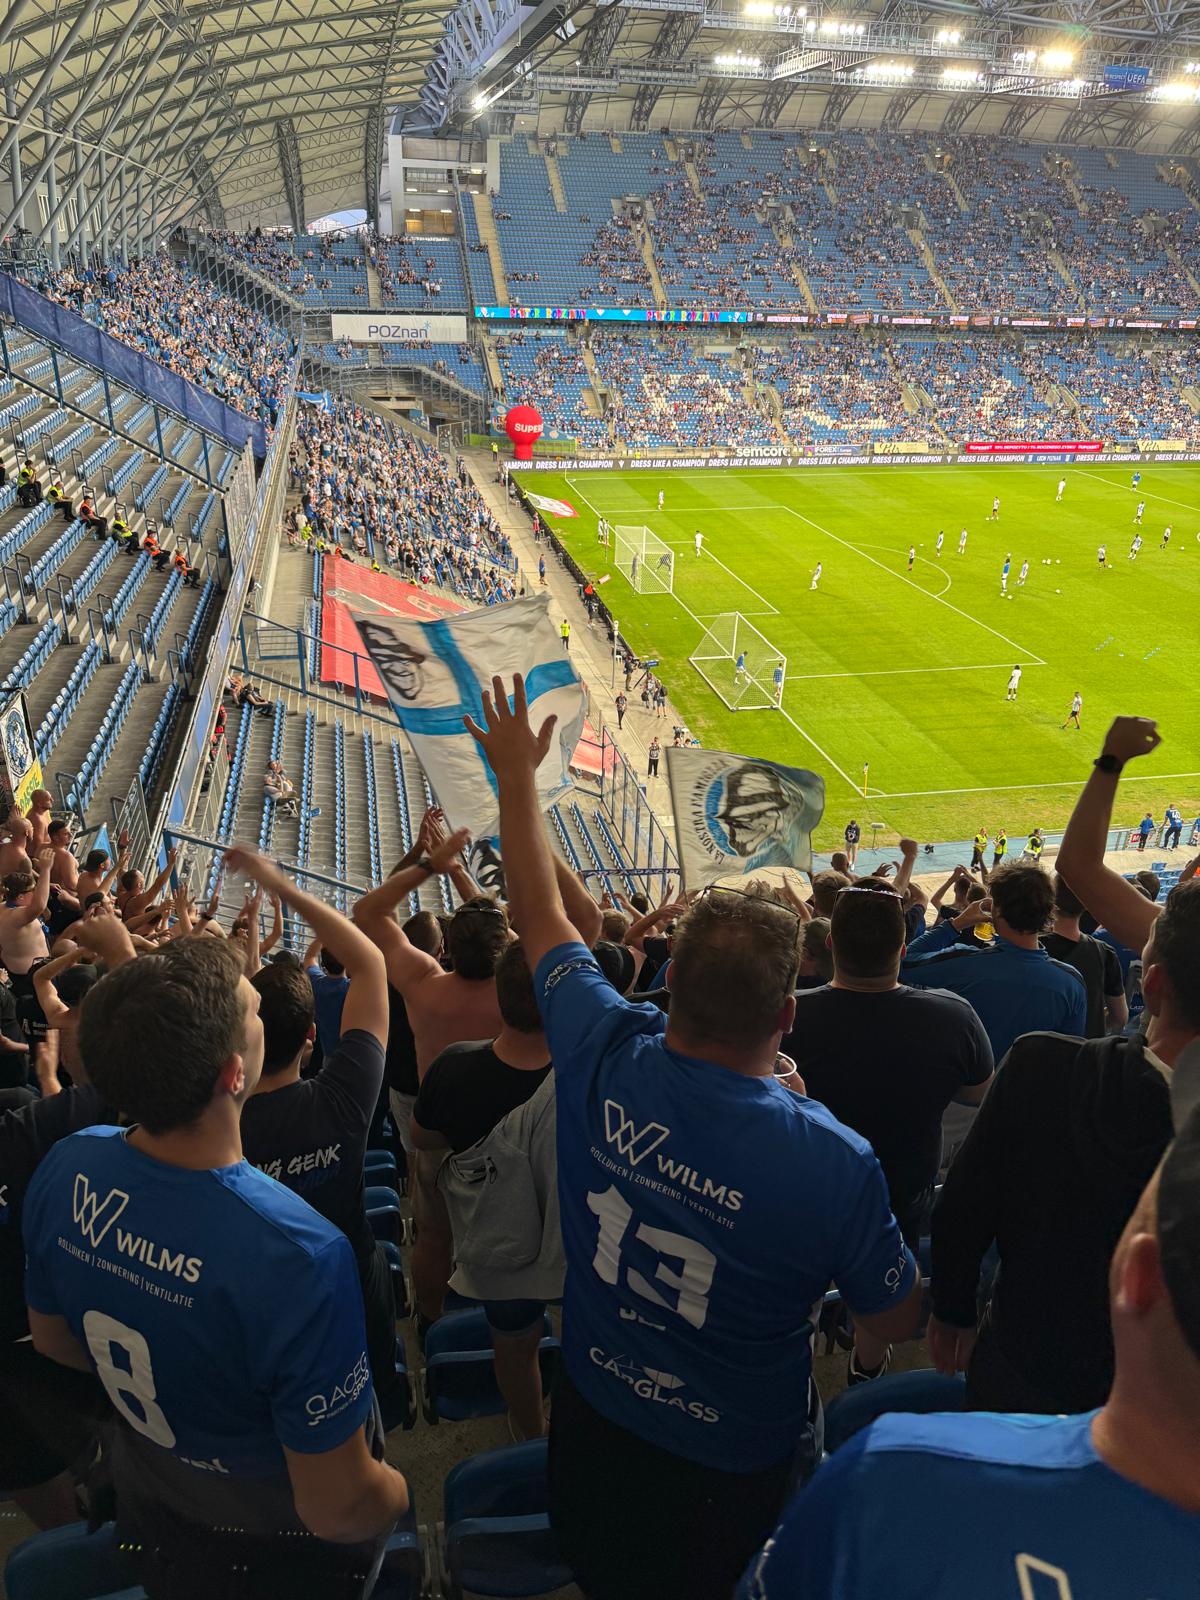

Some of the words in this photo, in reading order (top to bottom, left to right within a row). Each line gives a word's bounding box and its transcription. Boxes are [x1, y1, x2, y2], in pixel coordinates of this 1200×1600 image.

[1127, 73, 1146, 85] UEFA
[536, 461, 557, 469] DRESS
[579, 460, 613, 468] CHAMPION
[630, 460, 652, 468] DRESS
[652, 460, 666, 468] LIKE
[672, 459, 706, 467] CHAMPION
[730, 459, 743, 467] LIKE
[749, 458, 782, 466] CHAMPION
[872, 456, 892, 464] DRESS
[892, 456, 905, 464] LIKE
[911, 455, 942, 463] CHAMPION
[691, 811, 715, 856] NOSTRA
[287, 1143, 341, 1175] GENK
[590, 1146, 628, 1177] ROLLUIKEN
[634, 1174, 682, 1200] ZONWERING
[688, 1200, 736, 1230] VENTILATIE
[657, 1154, 744, 1211] WILMS
[58, 1236, 91, 1265] ROLLUIKEN
[96, 1257, 139, 1287] ZONWERING
[145, 1280, 195, 1308] VENTILATIE
[116, 1227, 203, 1283] WILMS
[586, 1183, 717, 1330] 13
[83, 1310, 177, 1449] 8
